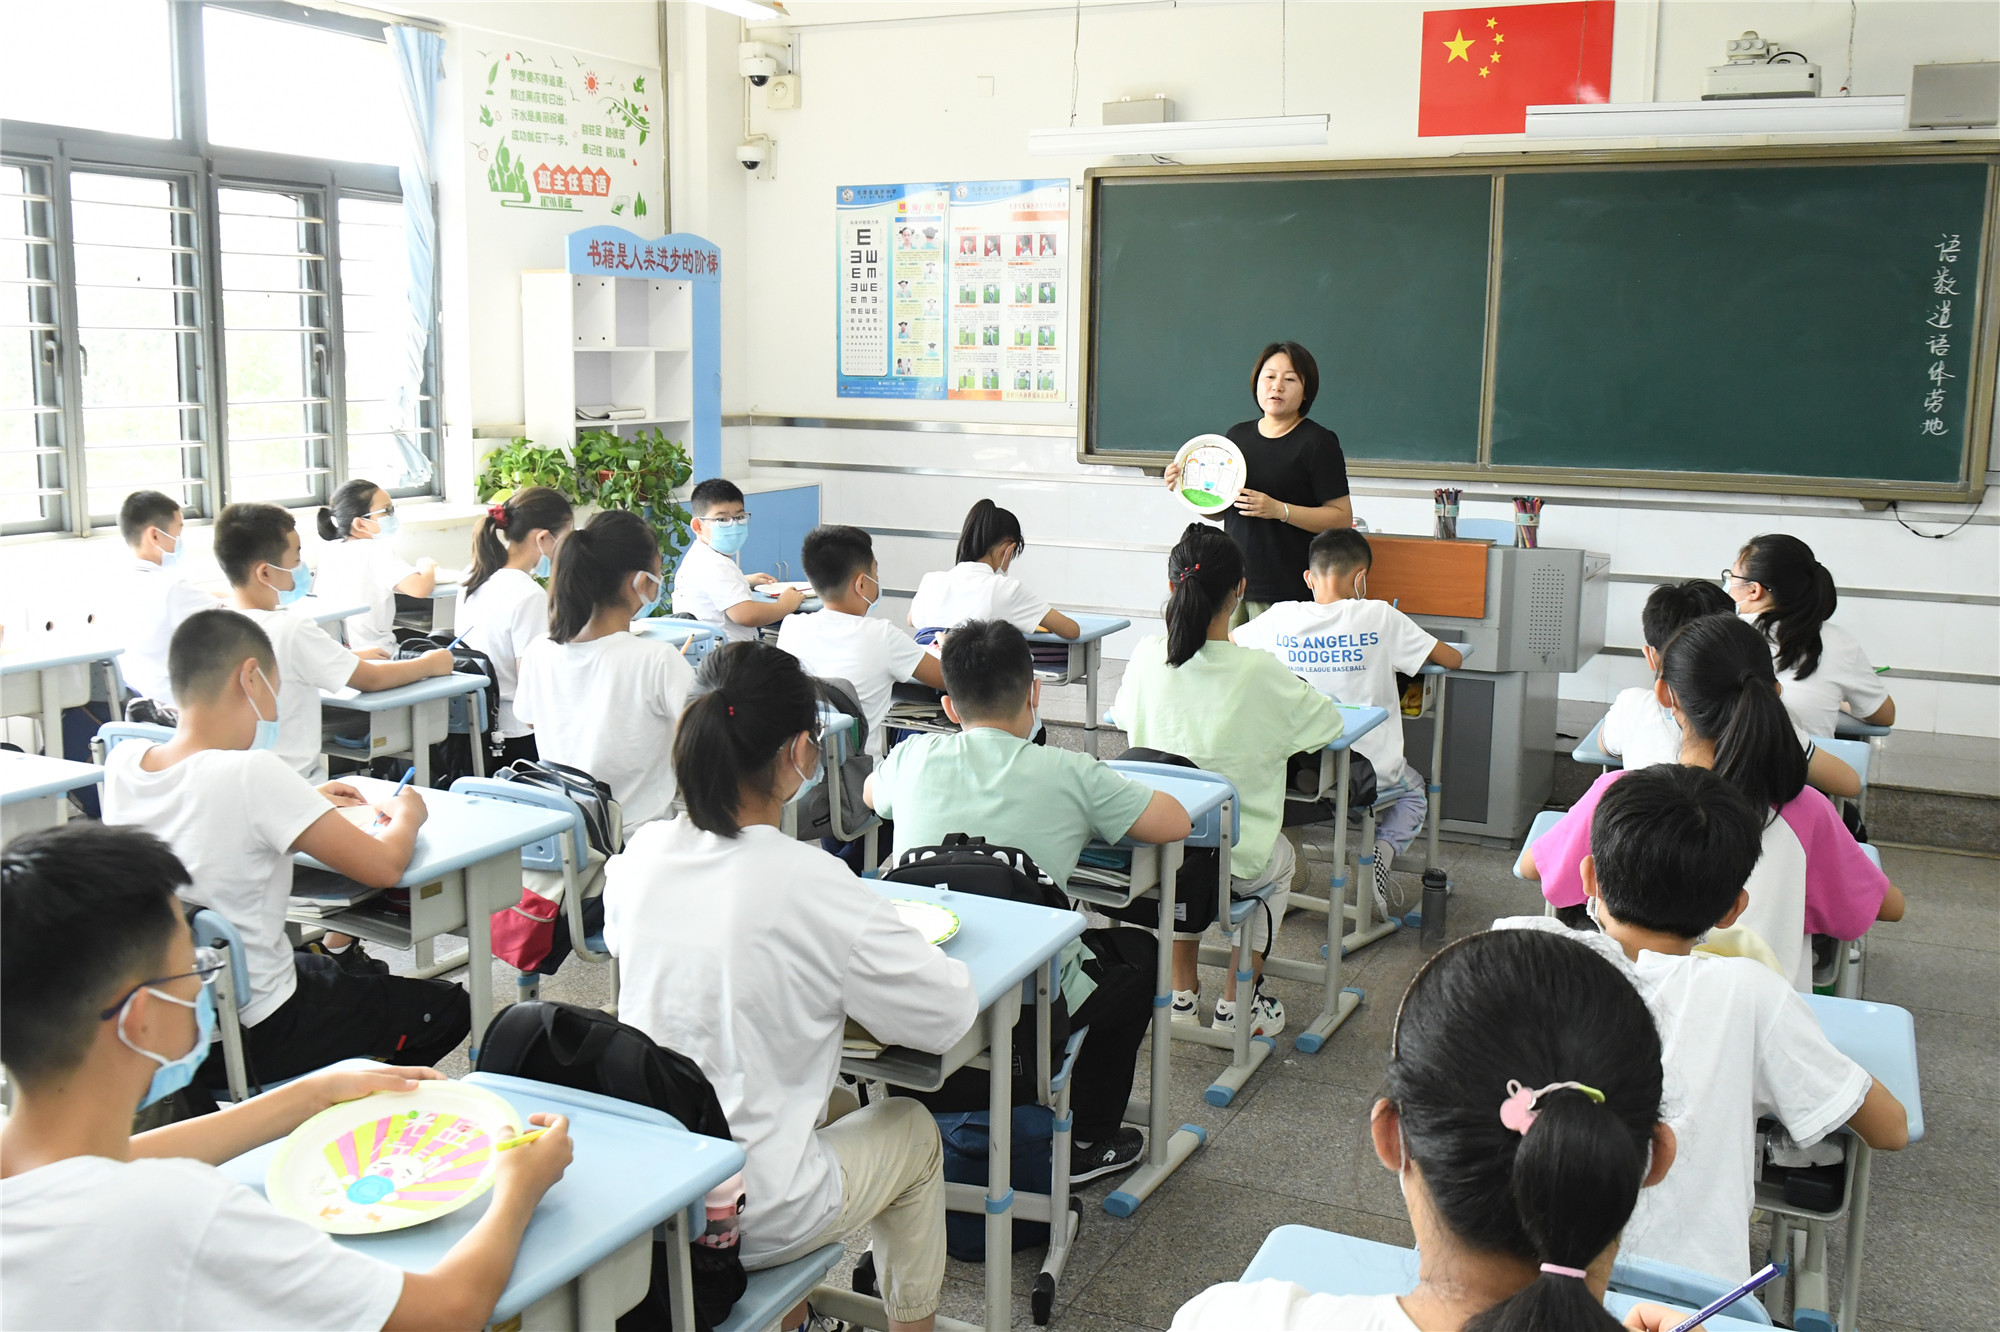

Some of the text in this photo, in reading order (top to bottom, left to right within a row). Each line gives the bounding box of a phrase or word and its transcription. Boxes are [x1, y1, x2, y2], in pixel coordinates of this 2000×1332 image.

[538, 169, 607, 194] 班主任寄语
[587, 239, 718, 276] 书籍是人类进步的阶梯
[1276, 632, 1379, 649] LOS ANGELES
[1288, 649, 1364, 663] DODGERS
[1332, 664, 1367, 672] BASEBALL
